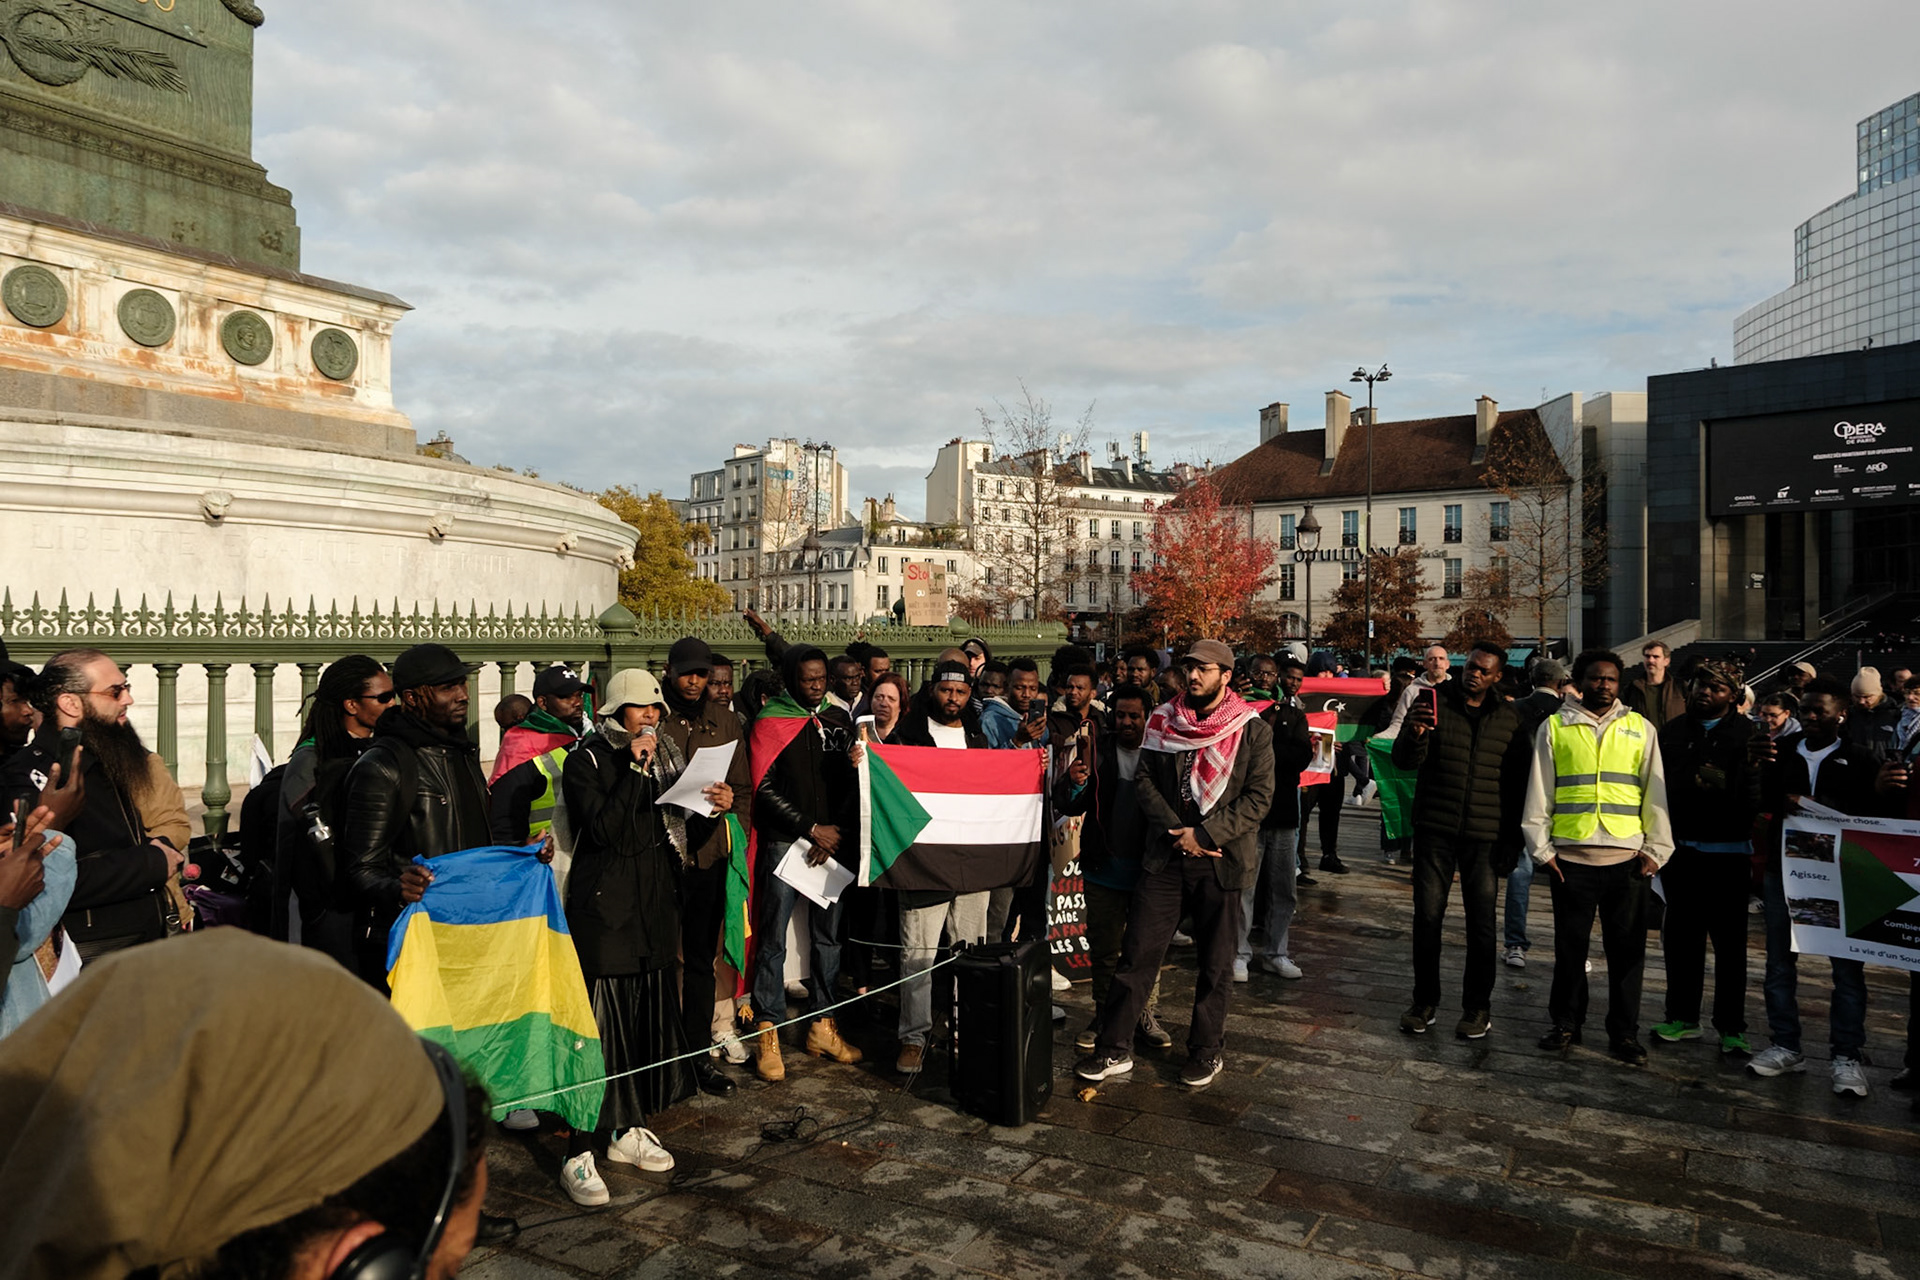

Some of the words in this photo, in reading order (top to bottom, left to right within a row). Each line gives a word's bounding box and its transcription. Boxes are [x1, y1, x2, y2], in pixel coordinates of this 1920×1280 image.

[1815, 814, 1850, 825] quelque
[1789, 869, 1831, 881] Agissez.
[1050, 938, 1073, 954] LES
[1849, 945, 1860, 953] La
[1862, 947, 1876, 956] vie
